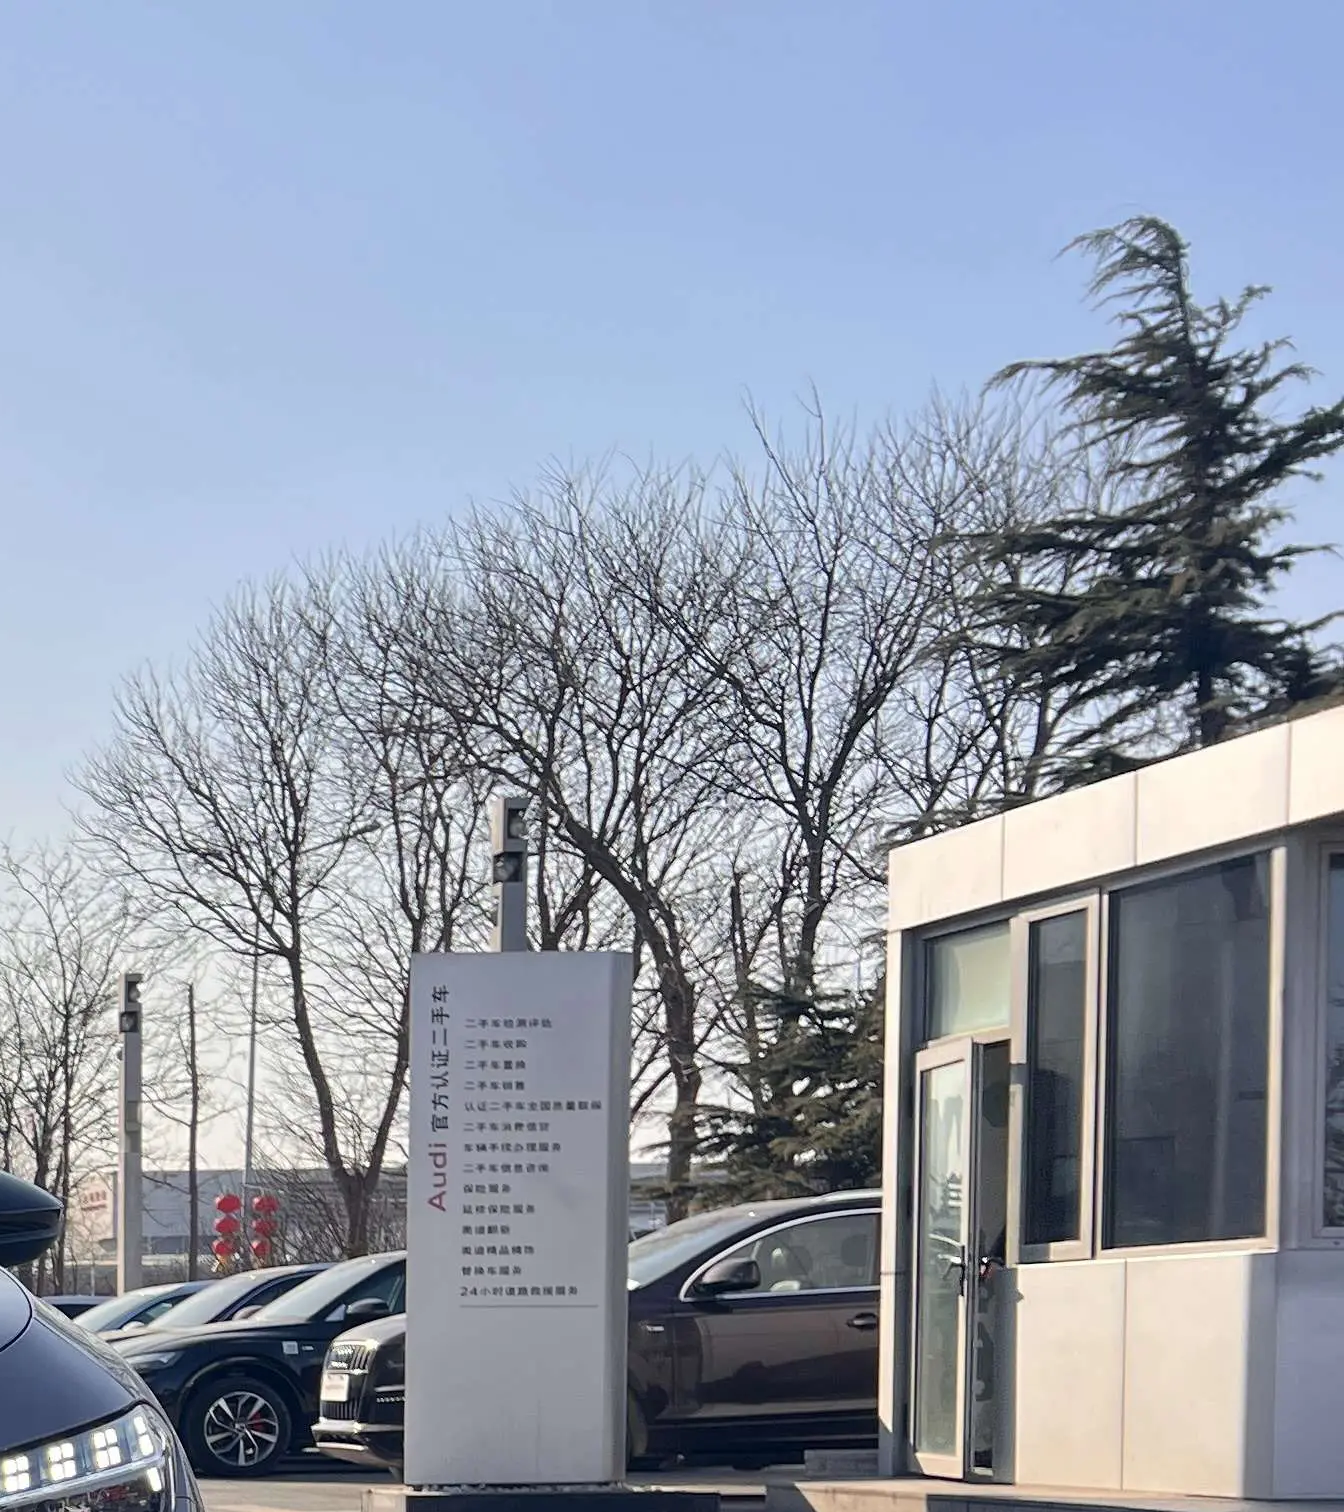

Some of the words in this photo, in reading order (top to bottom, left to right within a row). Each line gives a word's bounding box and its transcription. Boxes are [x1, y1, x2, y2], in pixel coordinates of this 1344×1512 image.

[430, 984, 451, 1133] 官方认证二手车
[427, 1143, 448, 1213] Audi
